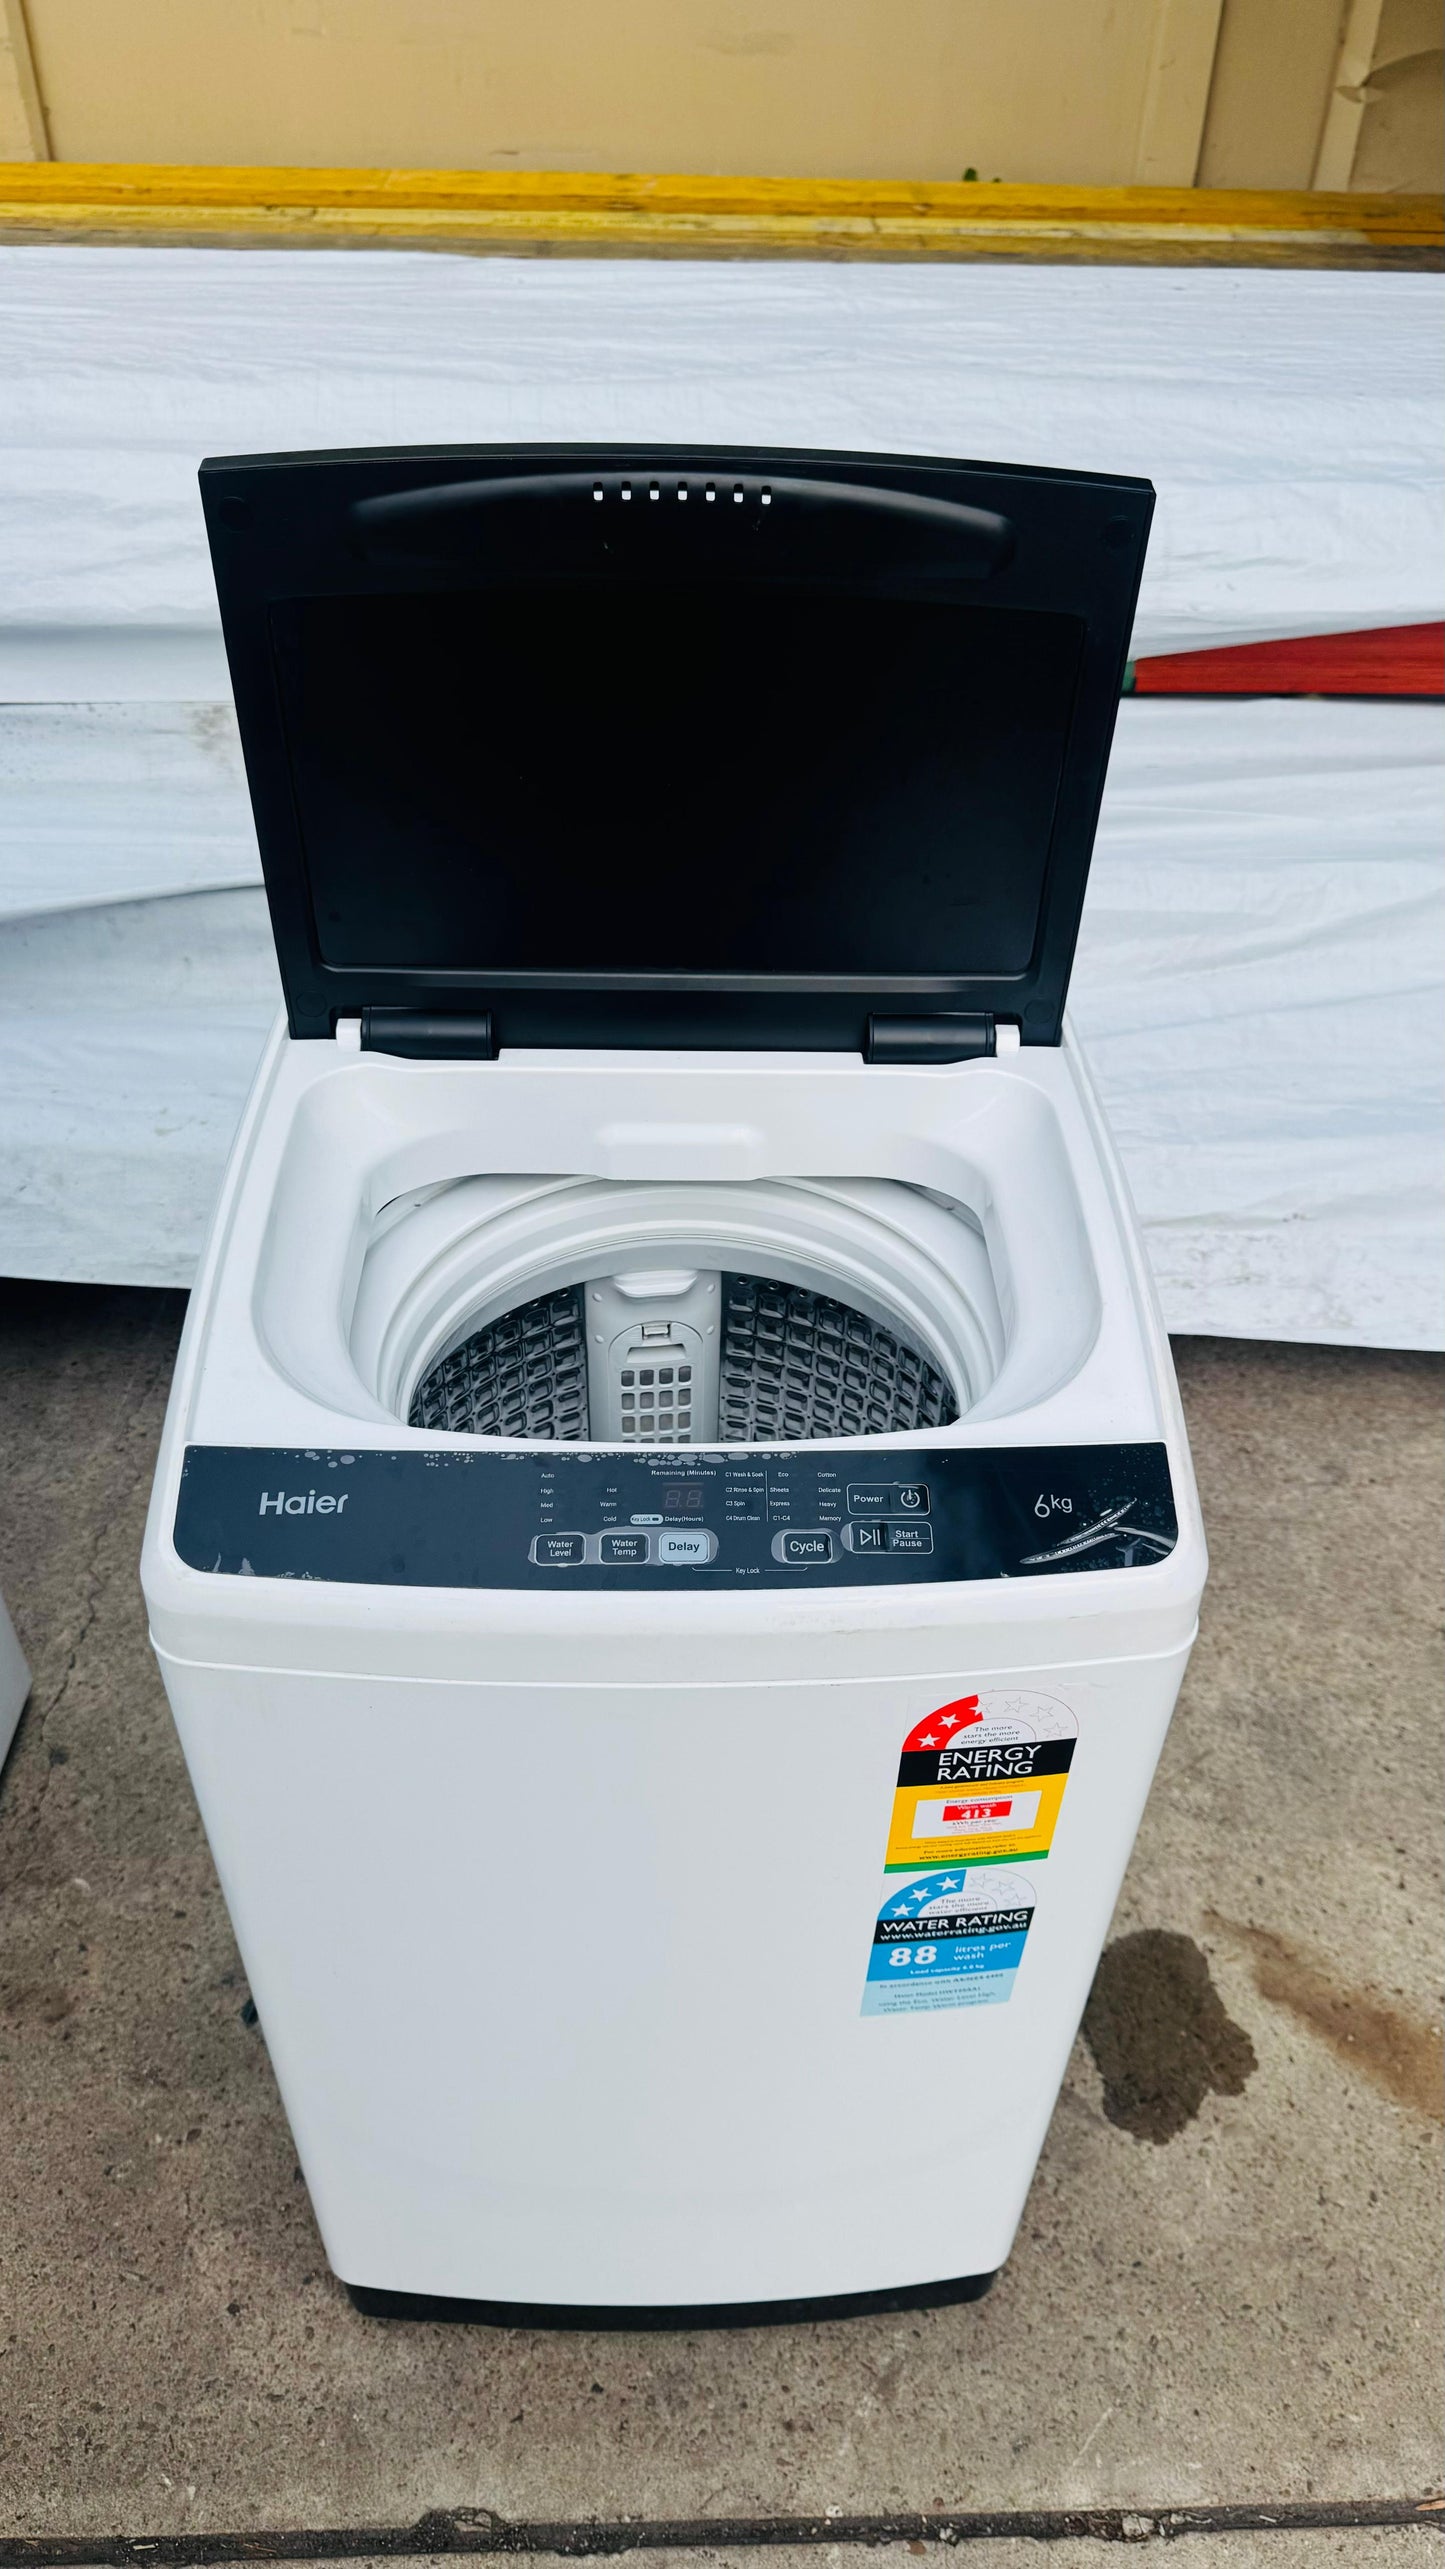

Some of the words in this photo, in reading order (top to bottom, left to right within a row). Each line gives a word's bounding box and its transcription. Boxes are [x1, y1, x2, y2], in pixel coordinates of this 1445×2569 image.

[686, 1469, 717, 1477] (Minutes)
[259, 1489, 349, 1516] Haier
[853, 1494, 884, 1503] Power
[895, 1530, 918, 1538] Start
[668, 1541, 700, 1553] Delay
[789, 1540, 825, 1555] Cycle
[892, 1539, 922, 1547] Pause
[550, 1549, 572, 1557] Level
[612, 1548, 637, 1557] Temp
[939, 1744, 1042, 1766] ENERGY
[937, 1761, 1034, 1781] RATING
[961, 1808, 992, 1819] 413
[883, 1919, 949, 1932] WATER
[955, 1910, 1028, 1928] RATING
[880, 1922, 1027, 1941] www.waterrating.gov.au
[955, 1945, 985, 1953] litres
[989, 1941, 1011, 1952] per
[888, 1945, 937, 1967] 88
[953, 1952, 984, 1961] wash
